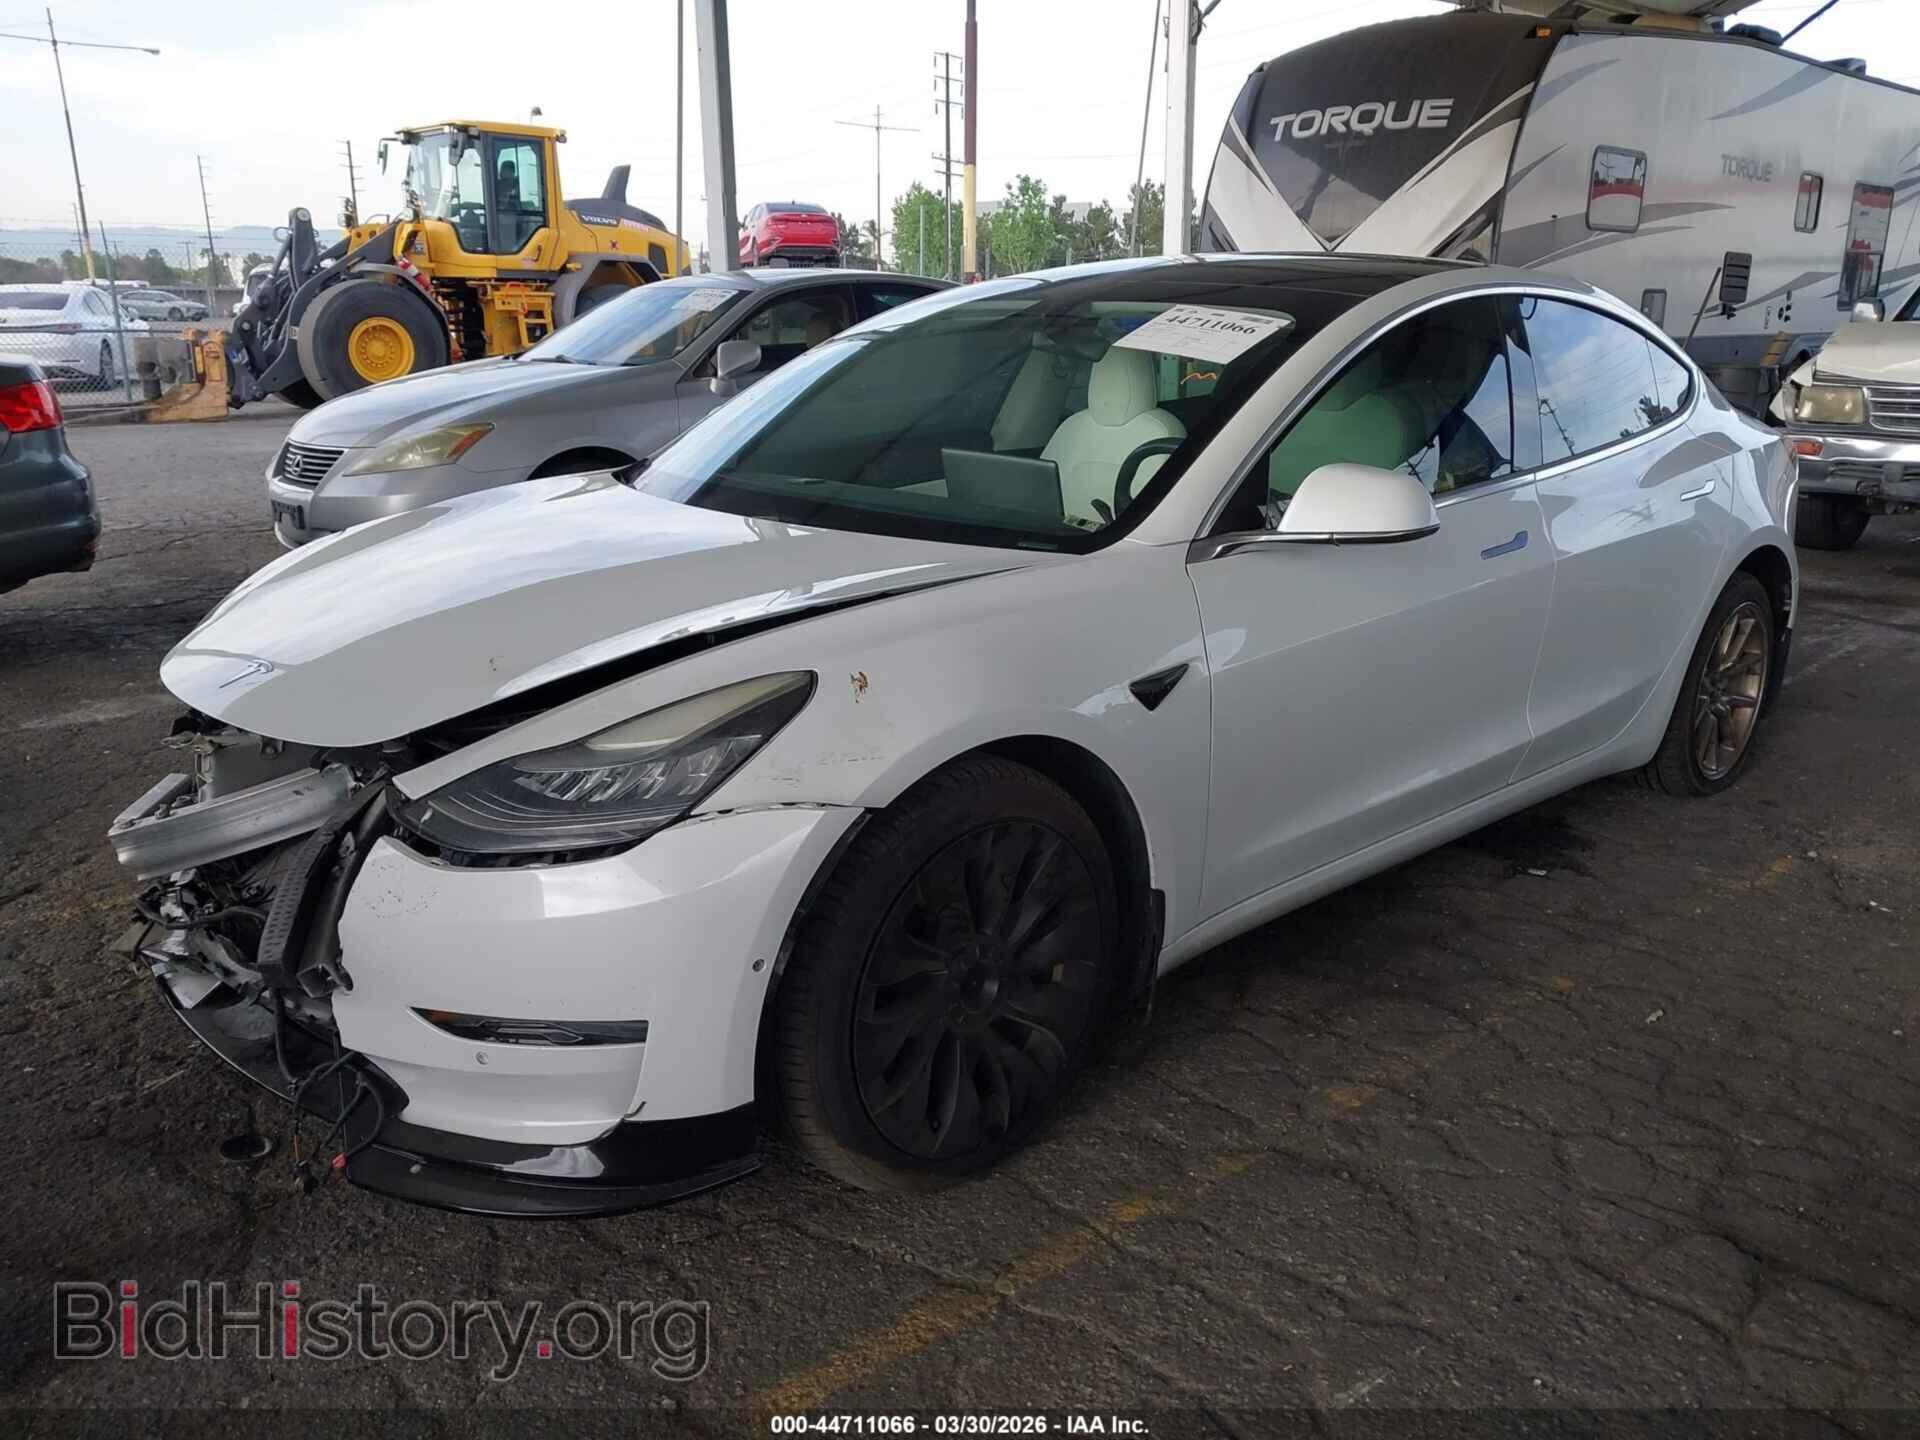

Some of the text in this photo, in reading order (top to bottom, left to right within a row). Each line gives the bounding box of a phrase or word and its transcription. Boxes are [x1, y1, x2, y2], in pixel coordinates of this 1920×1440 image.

[1270, 98, 1454, 142] TORQUE
[1721, 153, 1774, 183] TORQUE
[1165, 314, 1256, 335] 44711066
